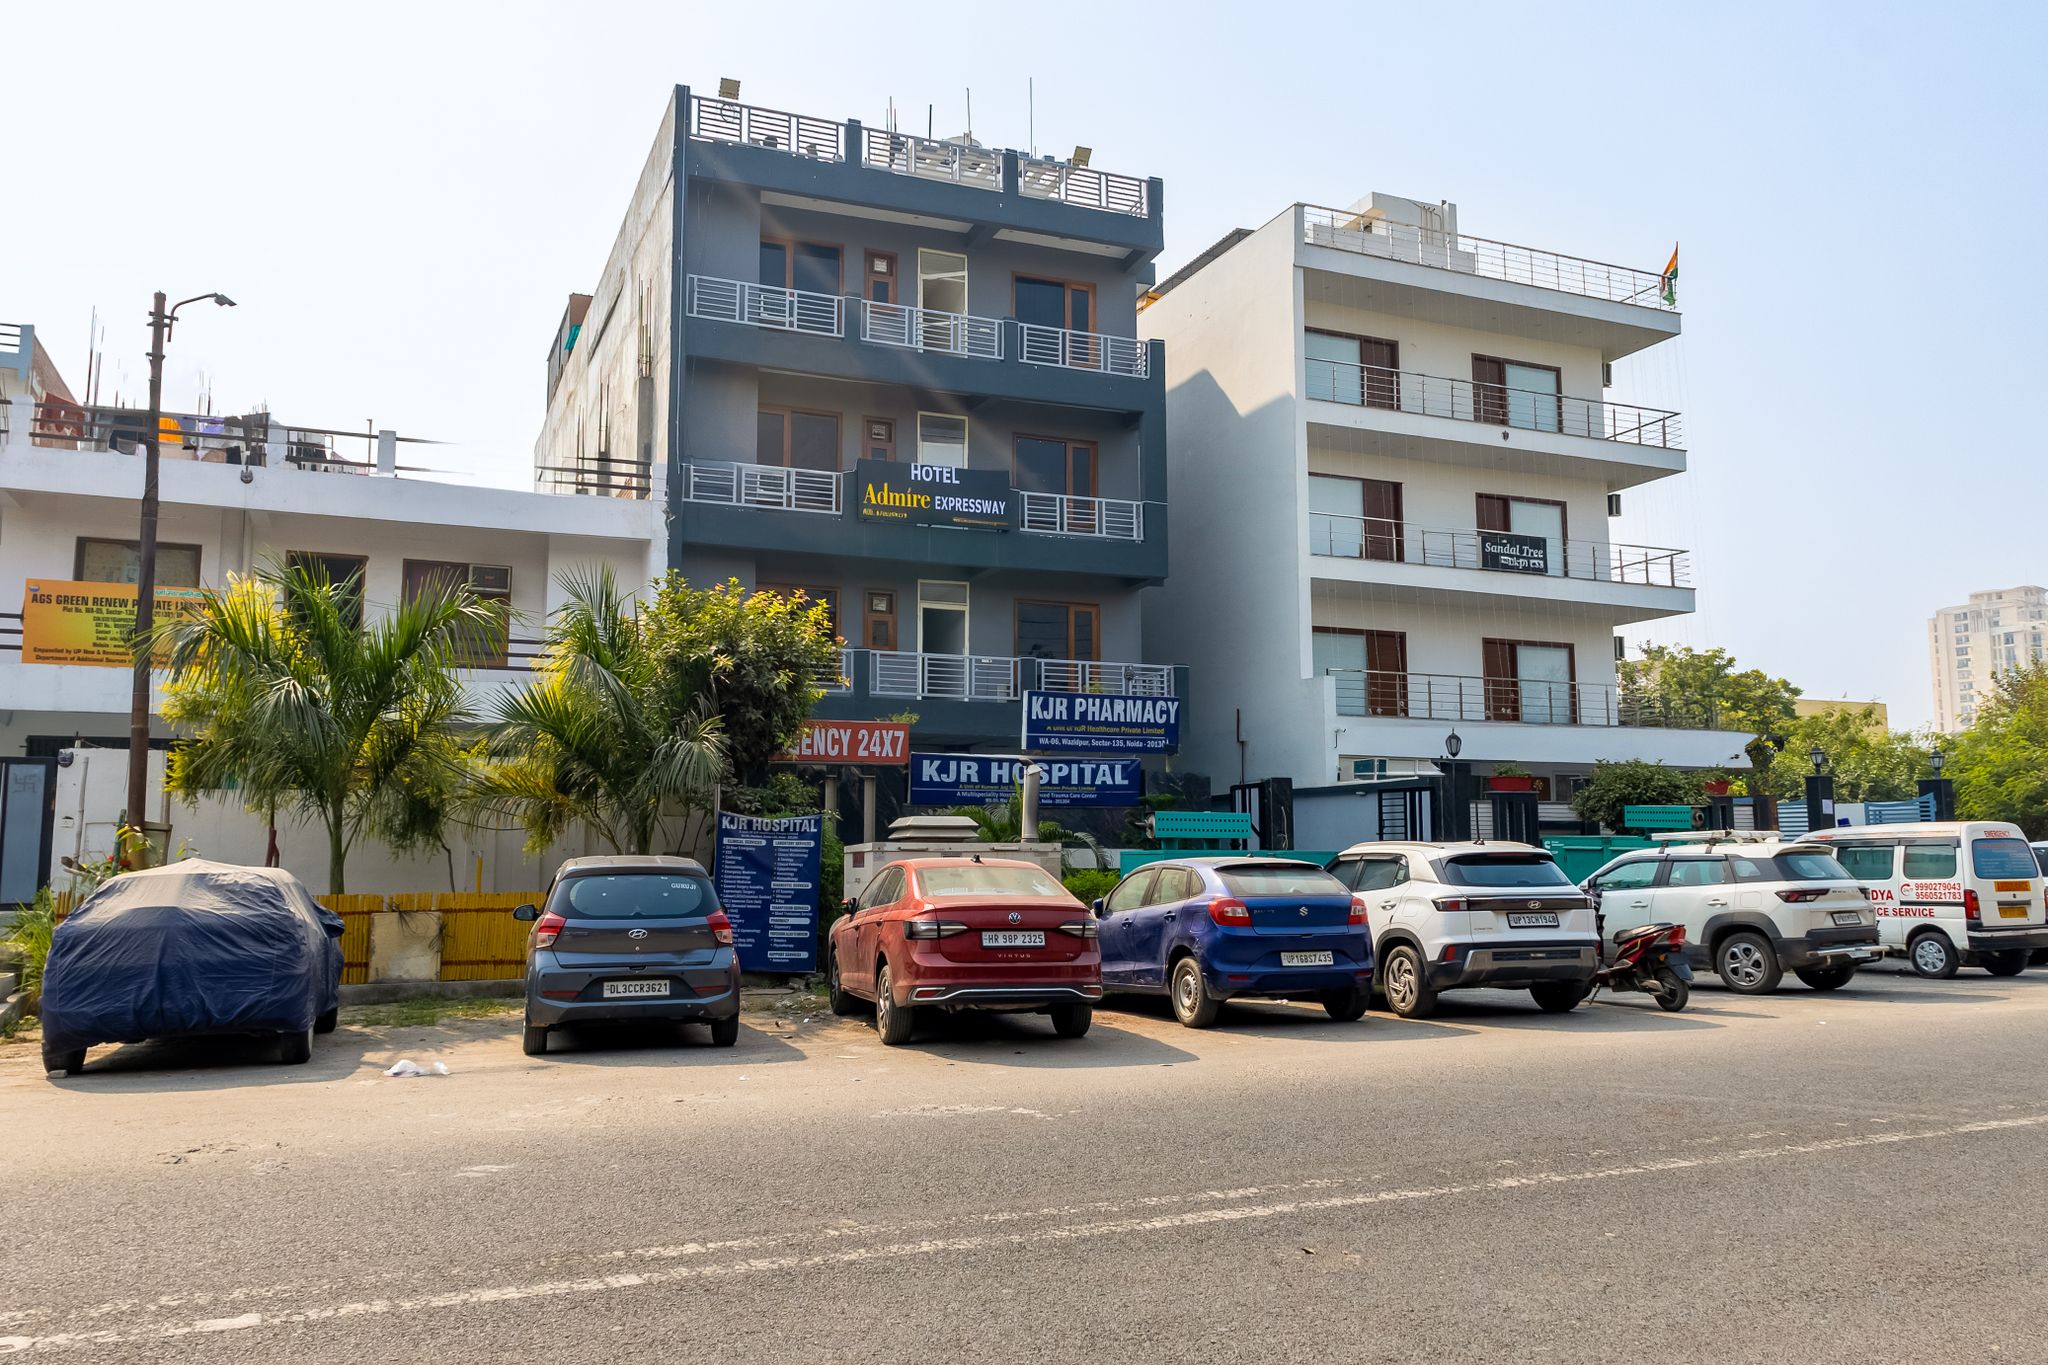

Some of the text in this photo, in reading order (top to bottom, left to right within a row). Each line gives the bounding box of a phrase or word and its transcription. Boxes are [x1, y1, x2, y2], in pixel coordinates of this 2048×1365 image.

[910, 462, 960, 484] HOTEL
[863, 482, 1006, 514] Admire EXPRESSWAY
[1485, 542, 1544, 558] Sandal Tree
[32, 594, 52, 604] AGS
[56, 595, 88, 606] GREEN
[92, 597, 128, 608] RENEW
[1031, 696, 1179, 724] KJR PHARMACY
[790, 728, 905, 757] ENCY 24X7
[1062, 738, 1090, 746] Wazidpur,
[1092, 739, 1125, 748] Sector-135,
[922, 759, 1129, 785] KJR HOSPITAL
[722, 816, 818, 832] KJR HOSPITAL
[1914, 883, 1961, 891] 9990279043
[1871, 889, 1894, 900] DYA
[1915, 891, 1961, 900] 9560521783
[1892, 908, 1935, 917] SERVICE
[988, 935, 1043, 944] HR 98P 2325
[1287, 953, 1332, 964] UP16BS7435
[610, 982, 668, 994] DL3CCR3621
